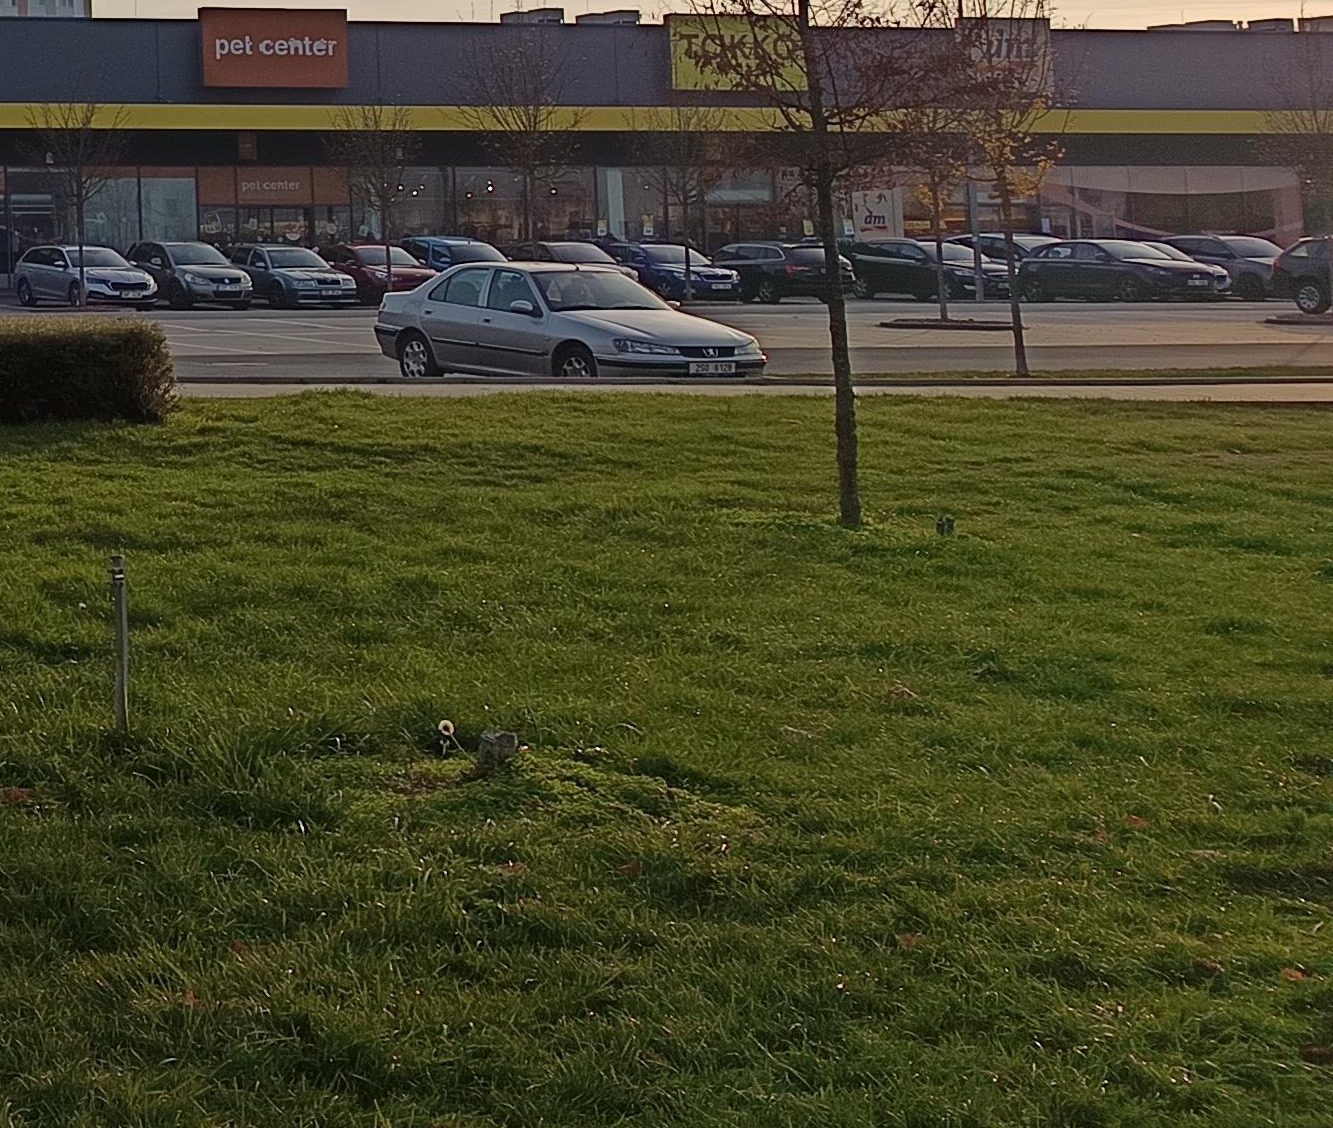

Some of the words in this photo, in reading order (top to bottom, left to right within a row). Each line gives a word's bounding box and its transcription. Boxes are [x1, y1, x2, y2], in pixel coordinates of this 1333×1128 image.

[215, 35, 253, 60] pet
[259, 36, 337, 56] center
[242, 180, 261, 192] pet
[263, 180, 300, 190] center
[864, 214, 886, 225] dm
